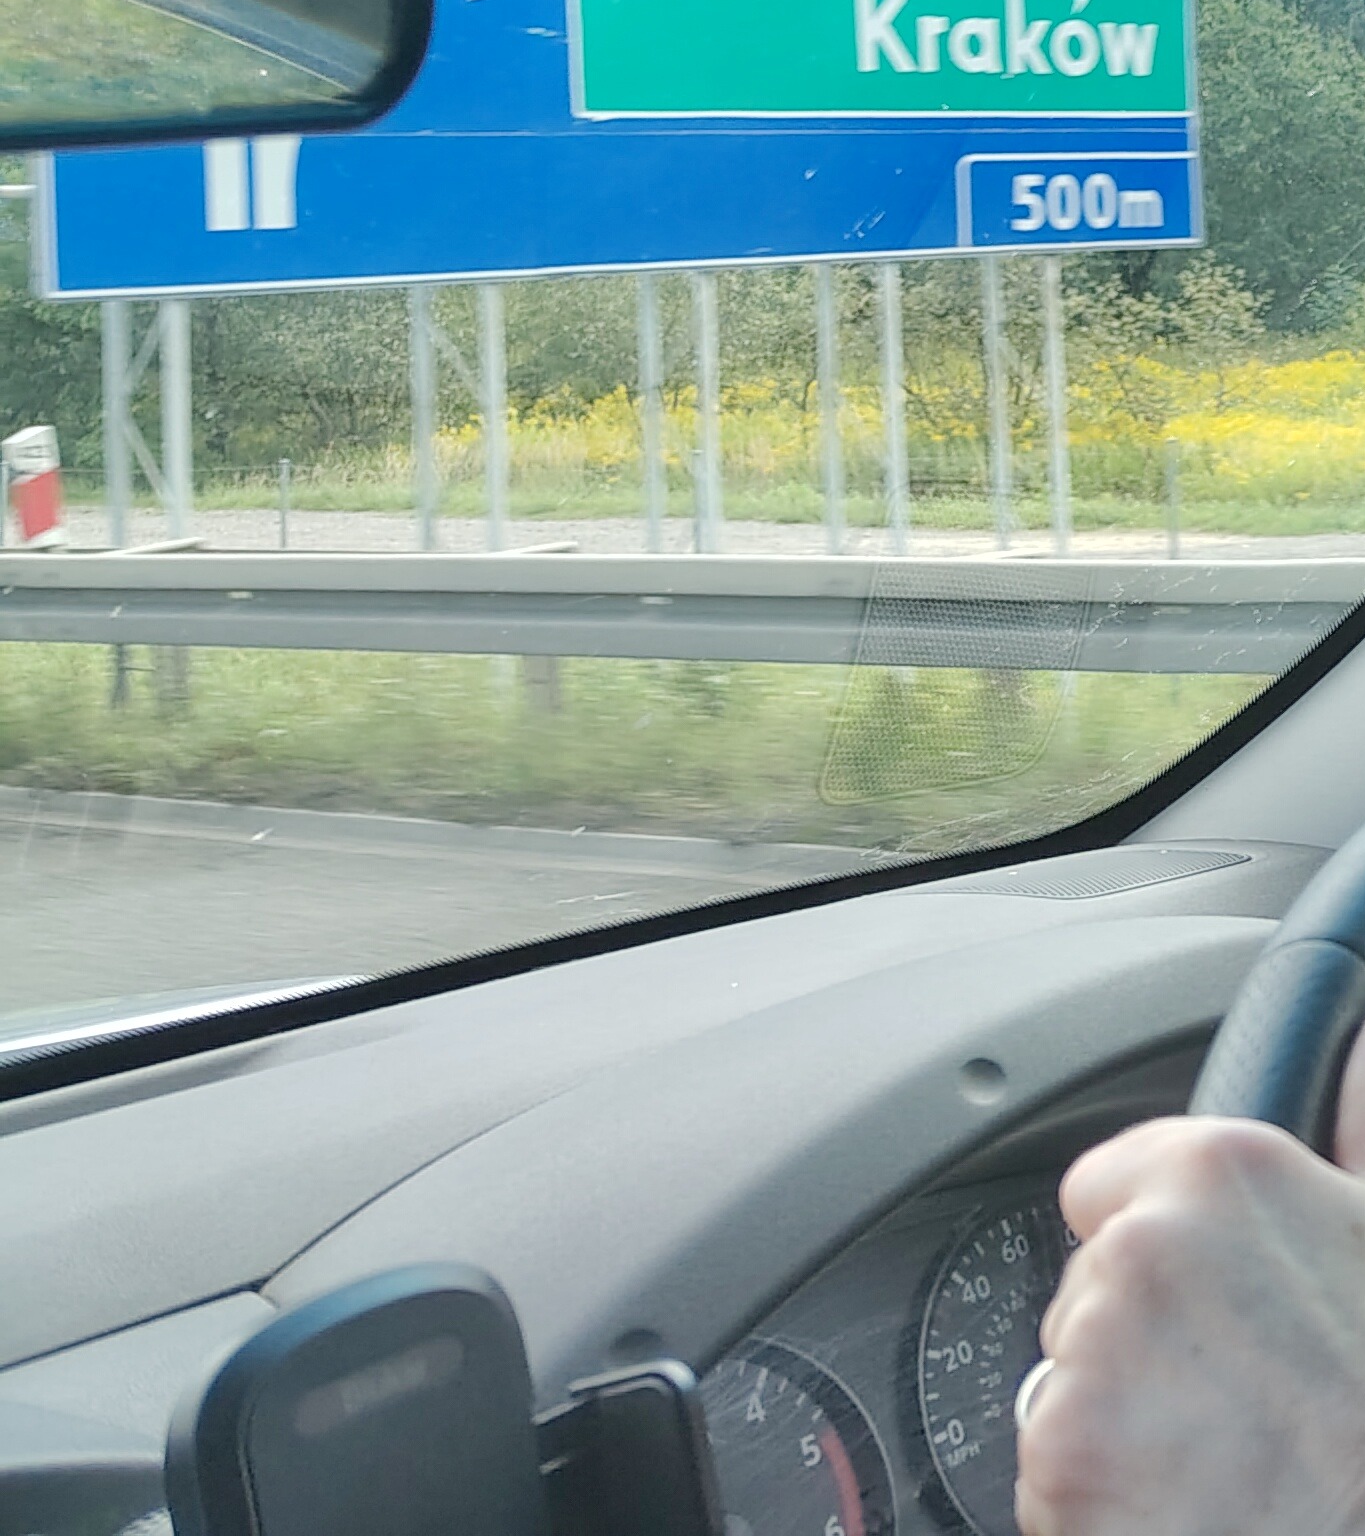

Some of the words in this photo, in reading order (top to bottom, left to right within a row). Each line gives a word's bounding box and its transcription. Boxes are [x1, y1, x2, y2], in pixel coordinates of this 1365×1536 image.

[1010, 173, 1164, 231] 500m
[1001, 1234, 1029, 1264] 60
[961, 1275, 991, 1303] 40
[942, 1340, 973, 1373] 20
[746, 1393, 767, 1423] 4
[947, 1418, 965, 1446] 0
[801, 1433, 823, 1467] 5
